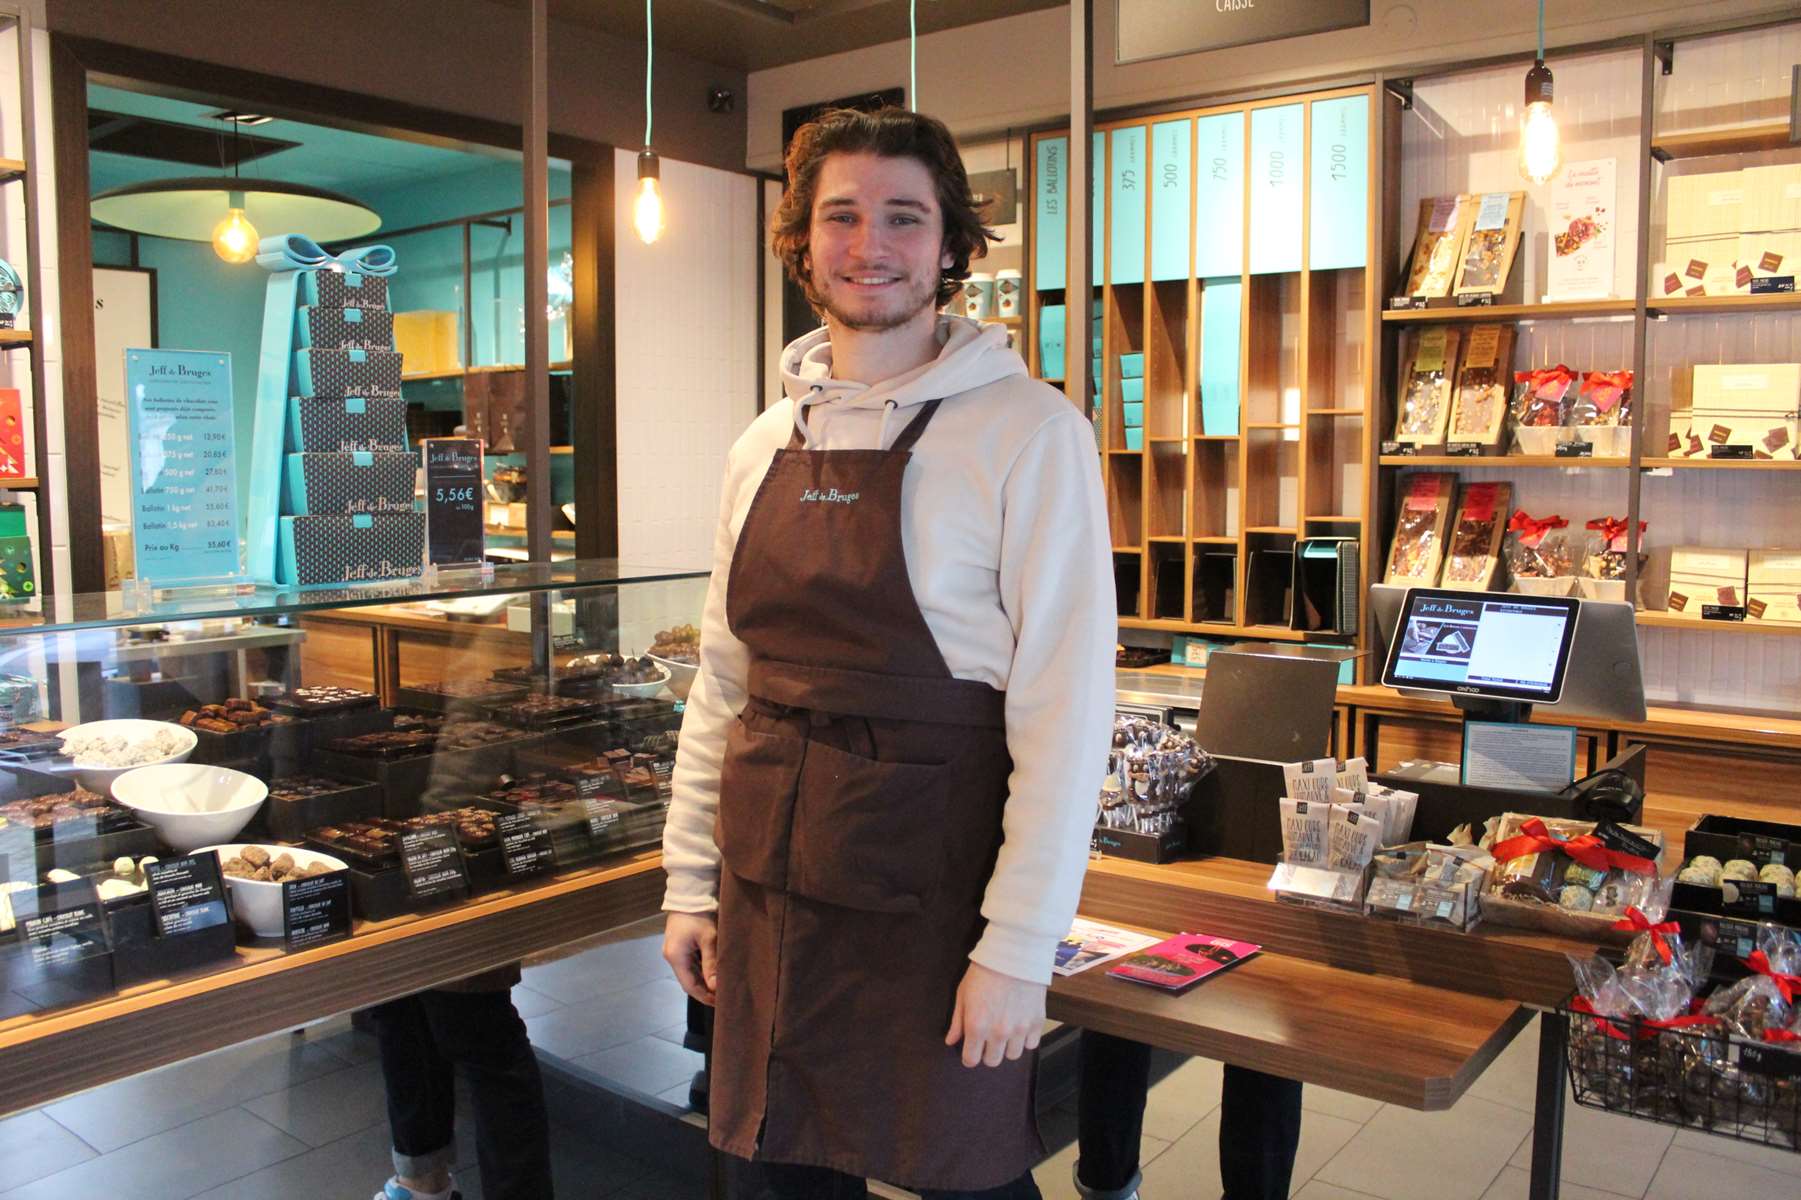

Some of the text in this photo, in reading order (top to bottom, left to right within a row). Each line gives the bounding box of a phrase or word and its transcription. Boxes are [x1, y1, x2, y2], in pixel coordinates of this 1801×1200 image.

[1211, 157, 1228, 181] 750
[1269, 151, 1285, 188] 1000
[1330, 144, 1347, 181] 1500
[1046, 145, 1058, 215] LES BALLOTINS
[1121, 169, 1136, 192] 375
[1162, 163, 1178, 188] 500
[149, 365, 168, 377] Jeff
[178, 364, 212, 378] Bruges
[344, 386, 361, 397] Jeff
[340, 441, 359, 453] Jeff
[430, 453, 444, 464] Jeff
[436, 488, 473, 504] 5,56€
[800, 488, 819, 502] Jeff
[827, 488, 860, 504] Bruges
[345, 500, 367, 514] Jeff
[462, 503, 475, 512] 100g
[169, 544, 180, 553] Kg
[343, 563, 368, 580] Jeff
[380, 560, 423, 576] Bruges
[1420, 603, 1438, 613] Jeff
[1444, 603, 1474, 616] Bruges
